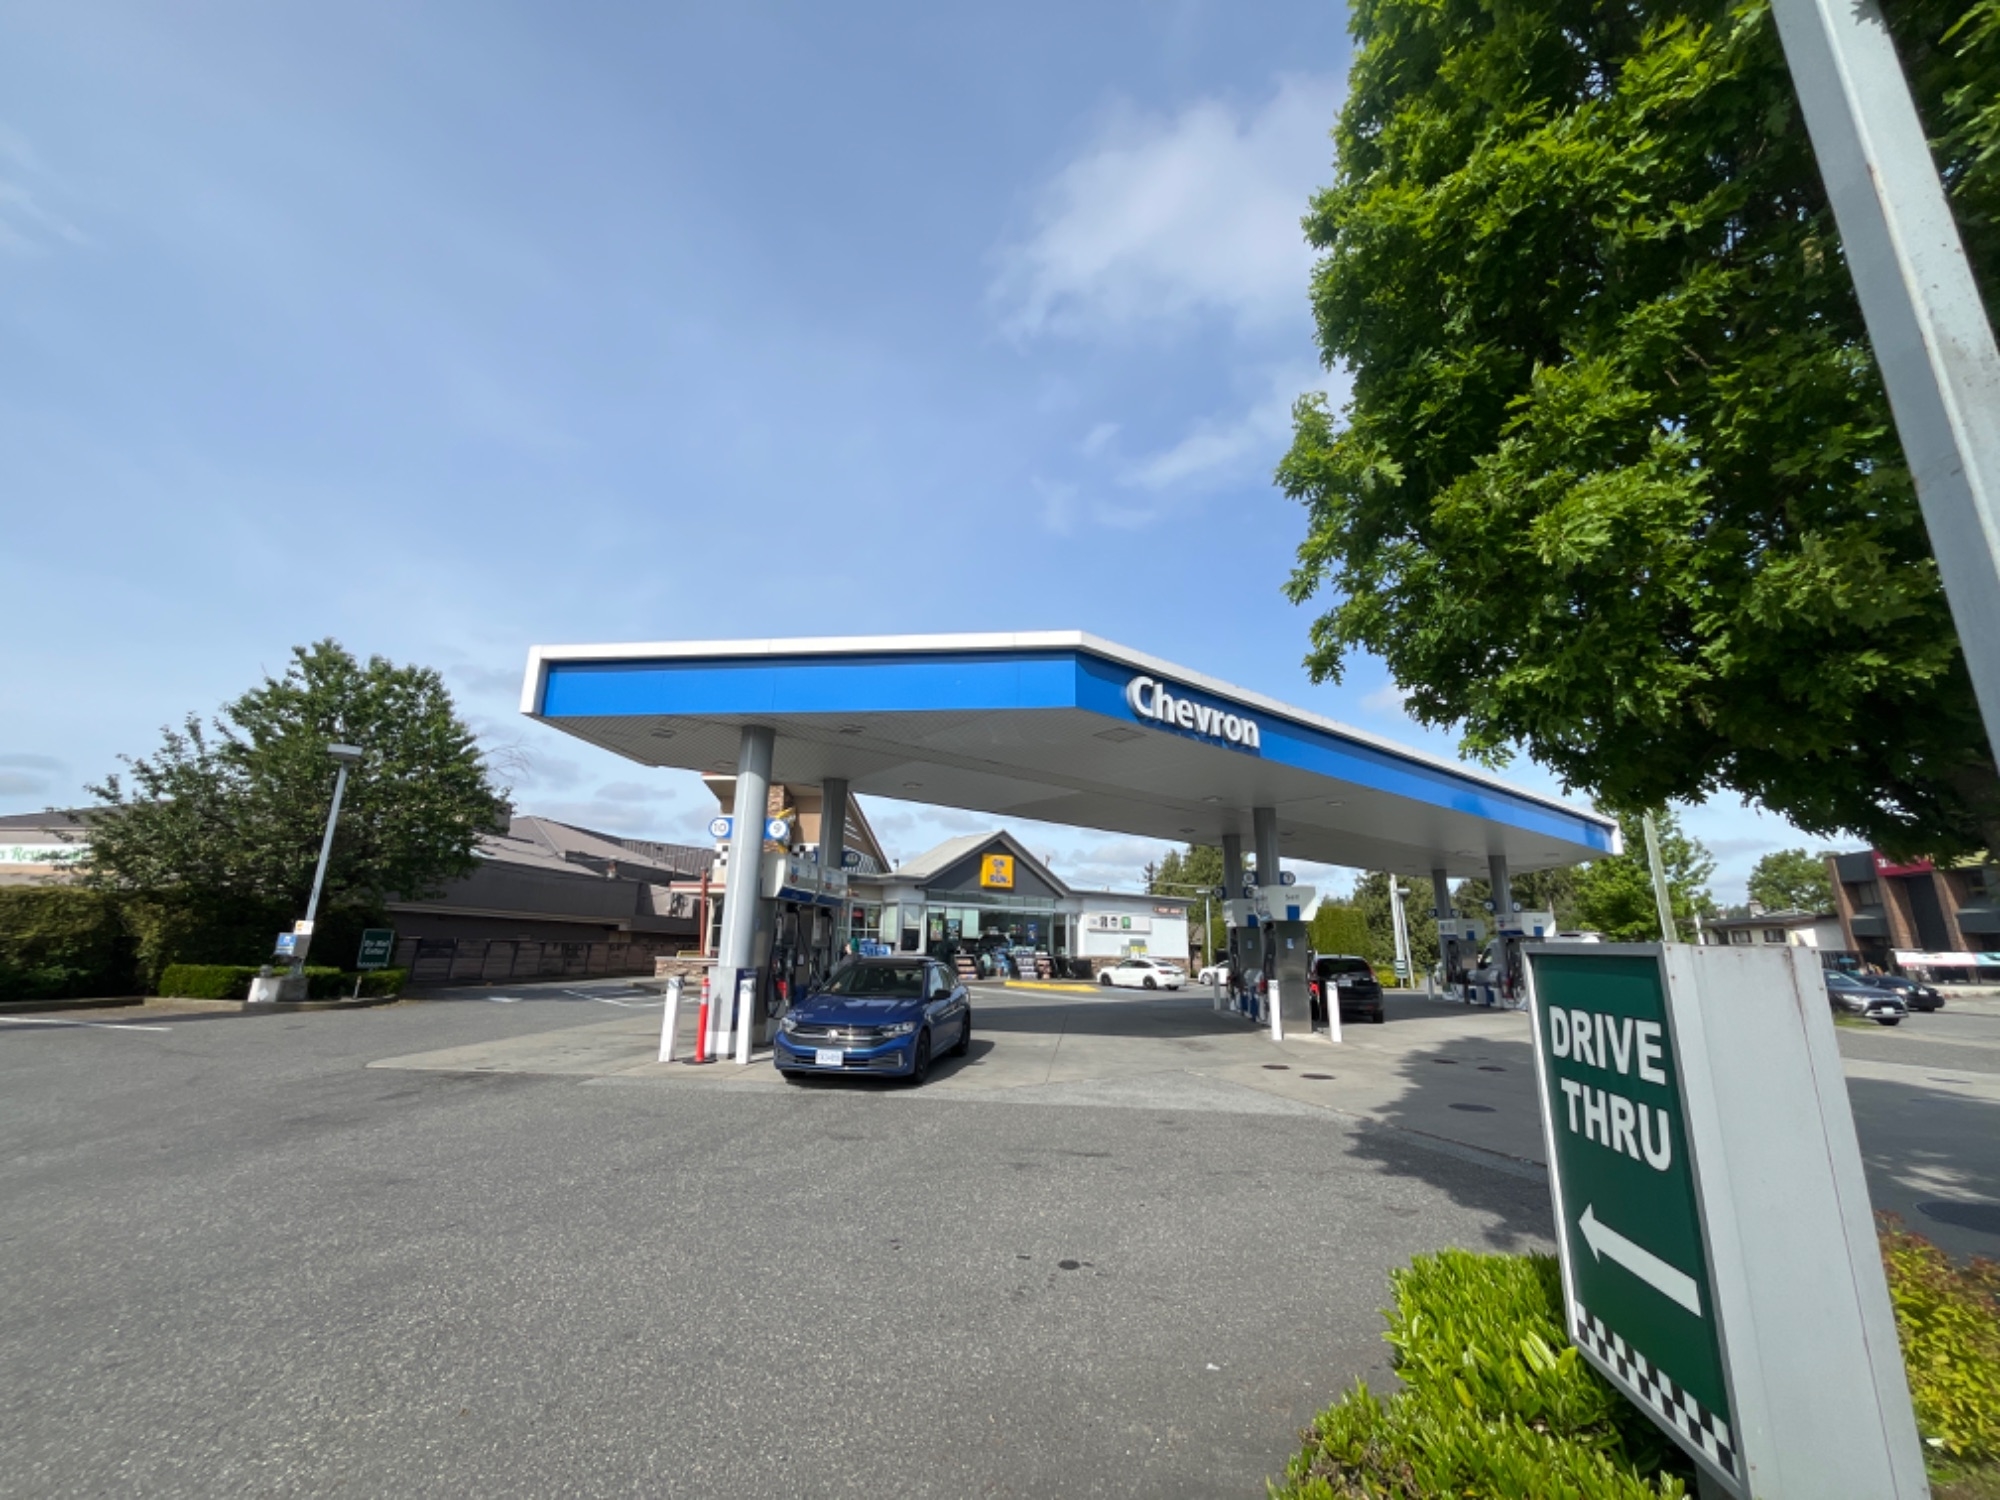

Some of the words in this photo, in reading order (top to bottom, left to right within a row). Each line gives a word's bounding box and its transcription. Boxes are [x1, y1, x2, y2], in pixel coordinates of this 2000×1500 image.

[1126, 676, 1260, 748] Chevron
[1549, 1005, 1666, 1086] DRIVE
[1561, 1077, 1672, 1172] THRU
